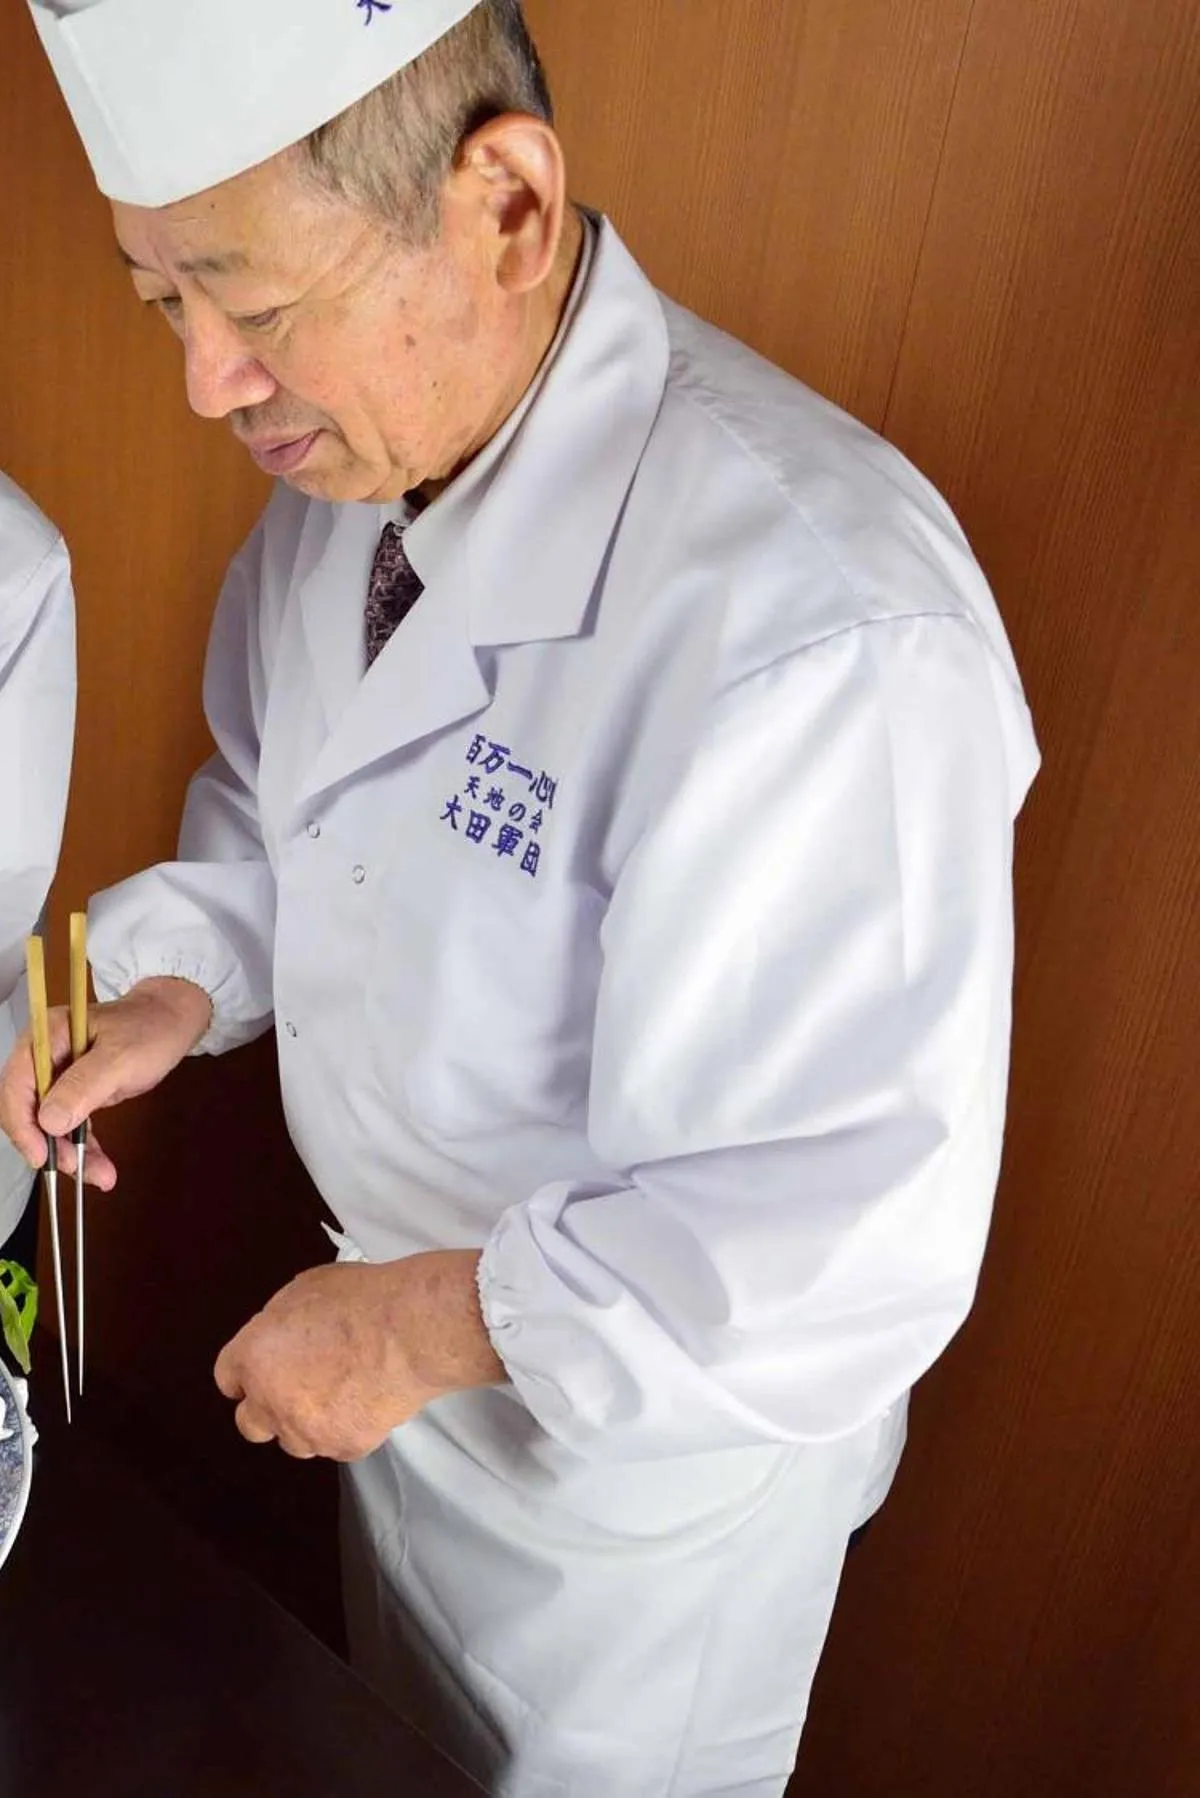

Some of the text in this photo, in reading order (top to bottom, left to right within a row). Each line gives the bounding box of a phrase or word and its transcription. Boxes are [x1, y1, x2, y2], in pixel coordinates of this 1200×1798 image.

[440, 794, 541, 877] 大田軍団
[464, 775, 543, 834] 天地の会
